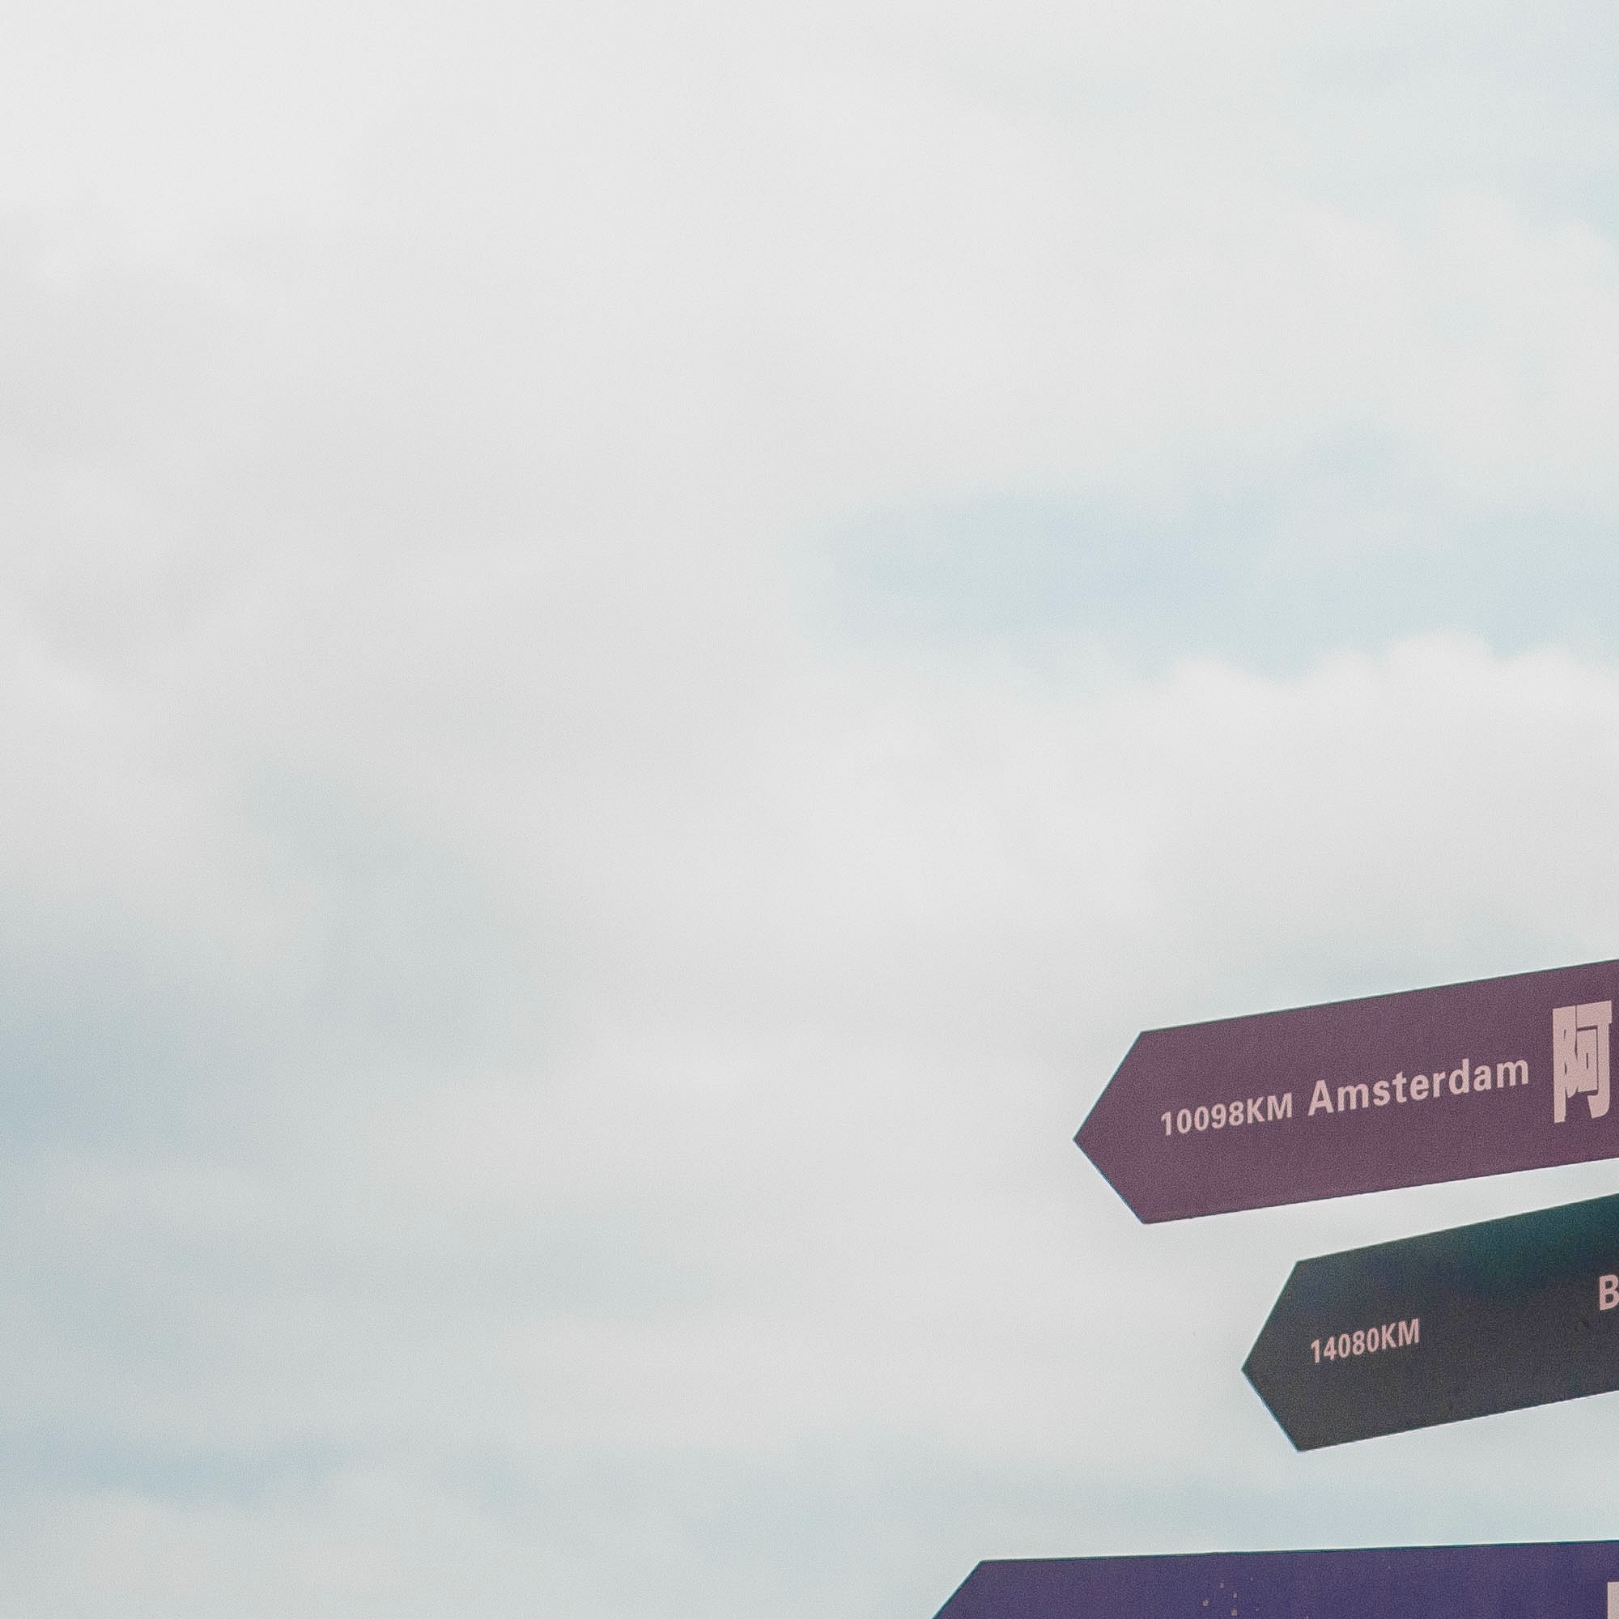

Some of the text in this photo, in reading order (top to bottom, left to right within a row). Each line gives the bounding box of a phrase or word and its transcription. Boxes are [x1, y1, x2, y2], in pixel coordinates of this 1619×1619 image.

[1161, 1093, 1294, 1136] 10098KM
[1307, 1055, 1530, 1117] Amsterdam
[1310, 1318, 1420, 1364] 14080KM
